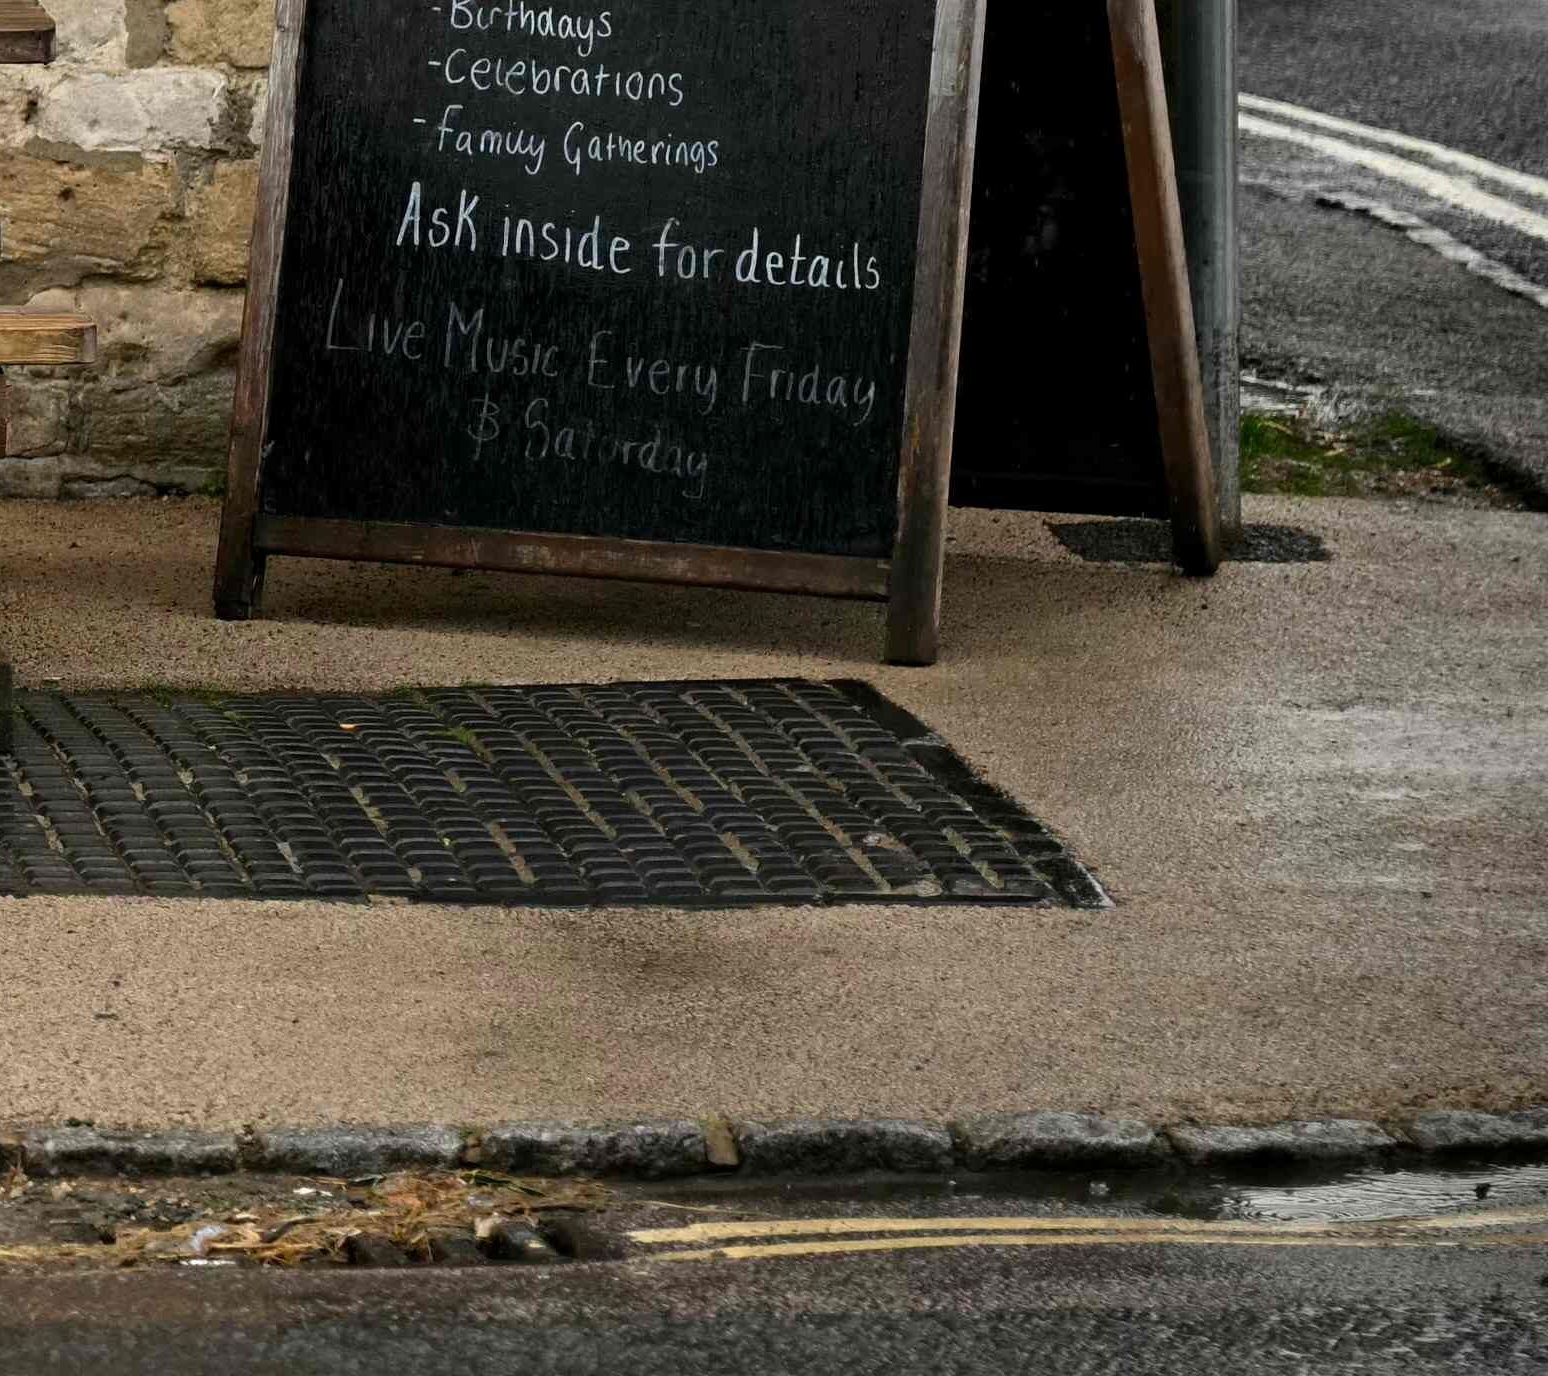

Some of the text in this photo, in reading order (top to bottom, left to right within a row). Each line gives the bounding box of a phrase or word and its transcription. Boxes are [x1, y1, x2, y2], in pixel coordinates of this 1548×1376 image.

[564, 122, 719, 176] Gatherings
[396, 181, 880, 289] Ask inside for details
[326, 278, 876, 426] Live Music Every Friday
